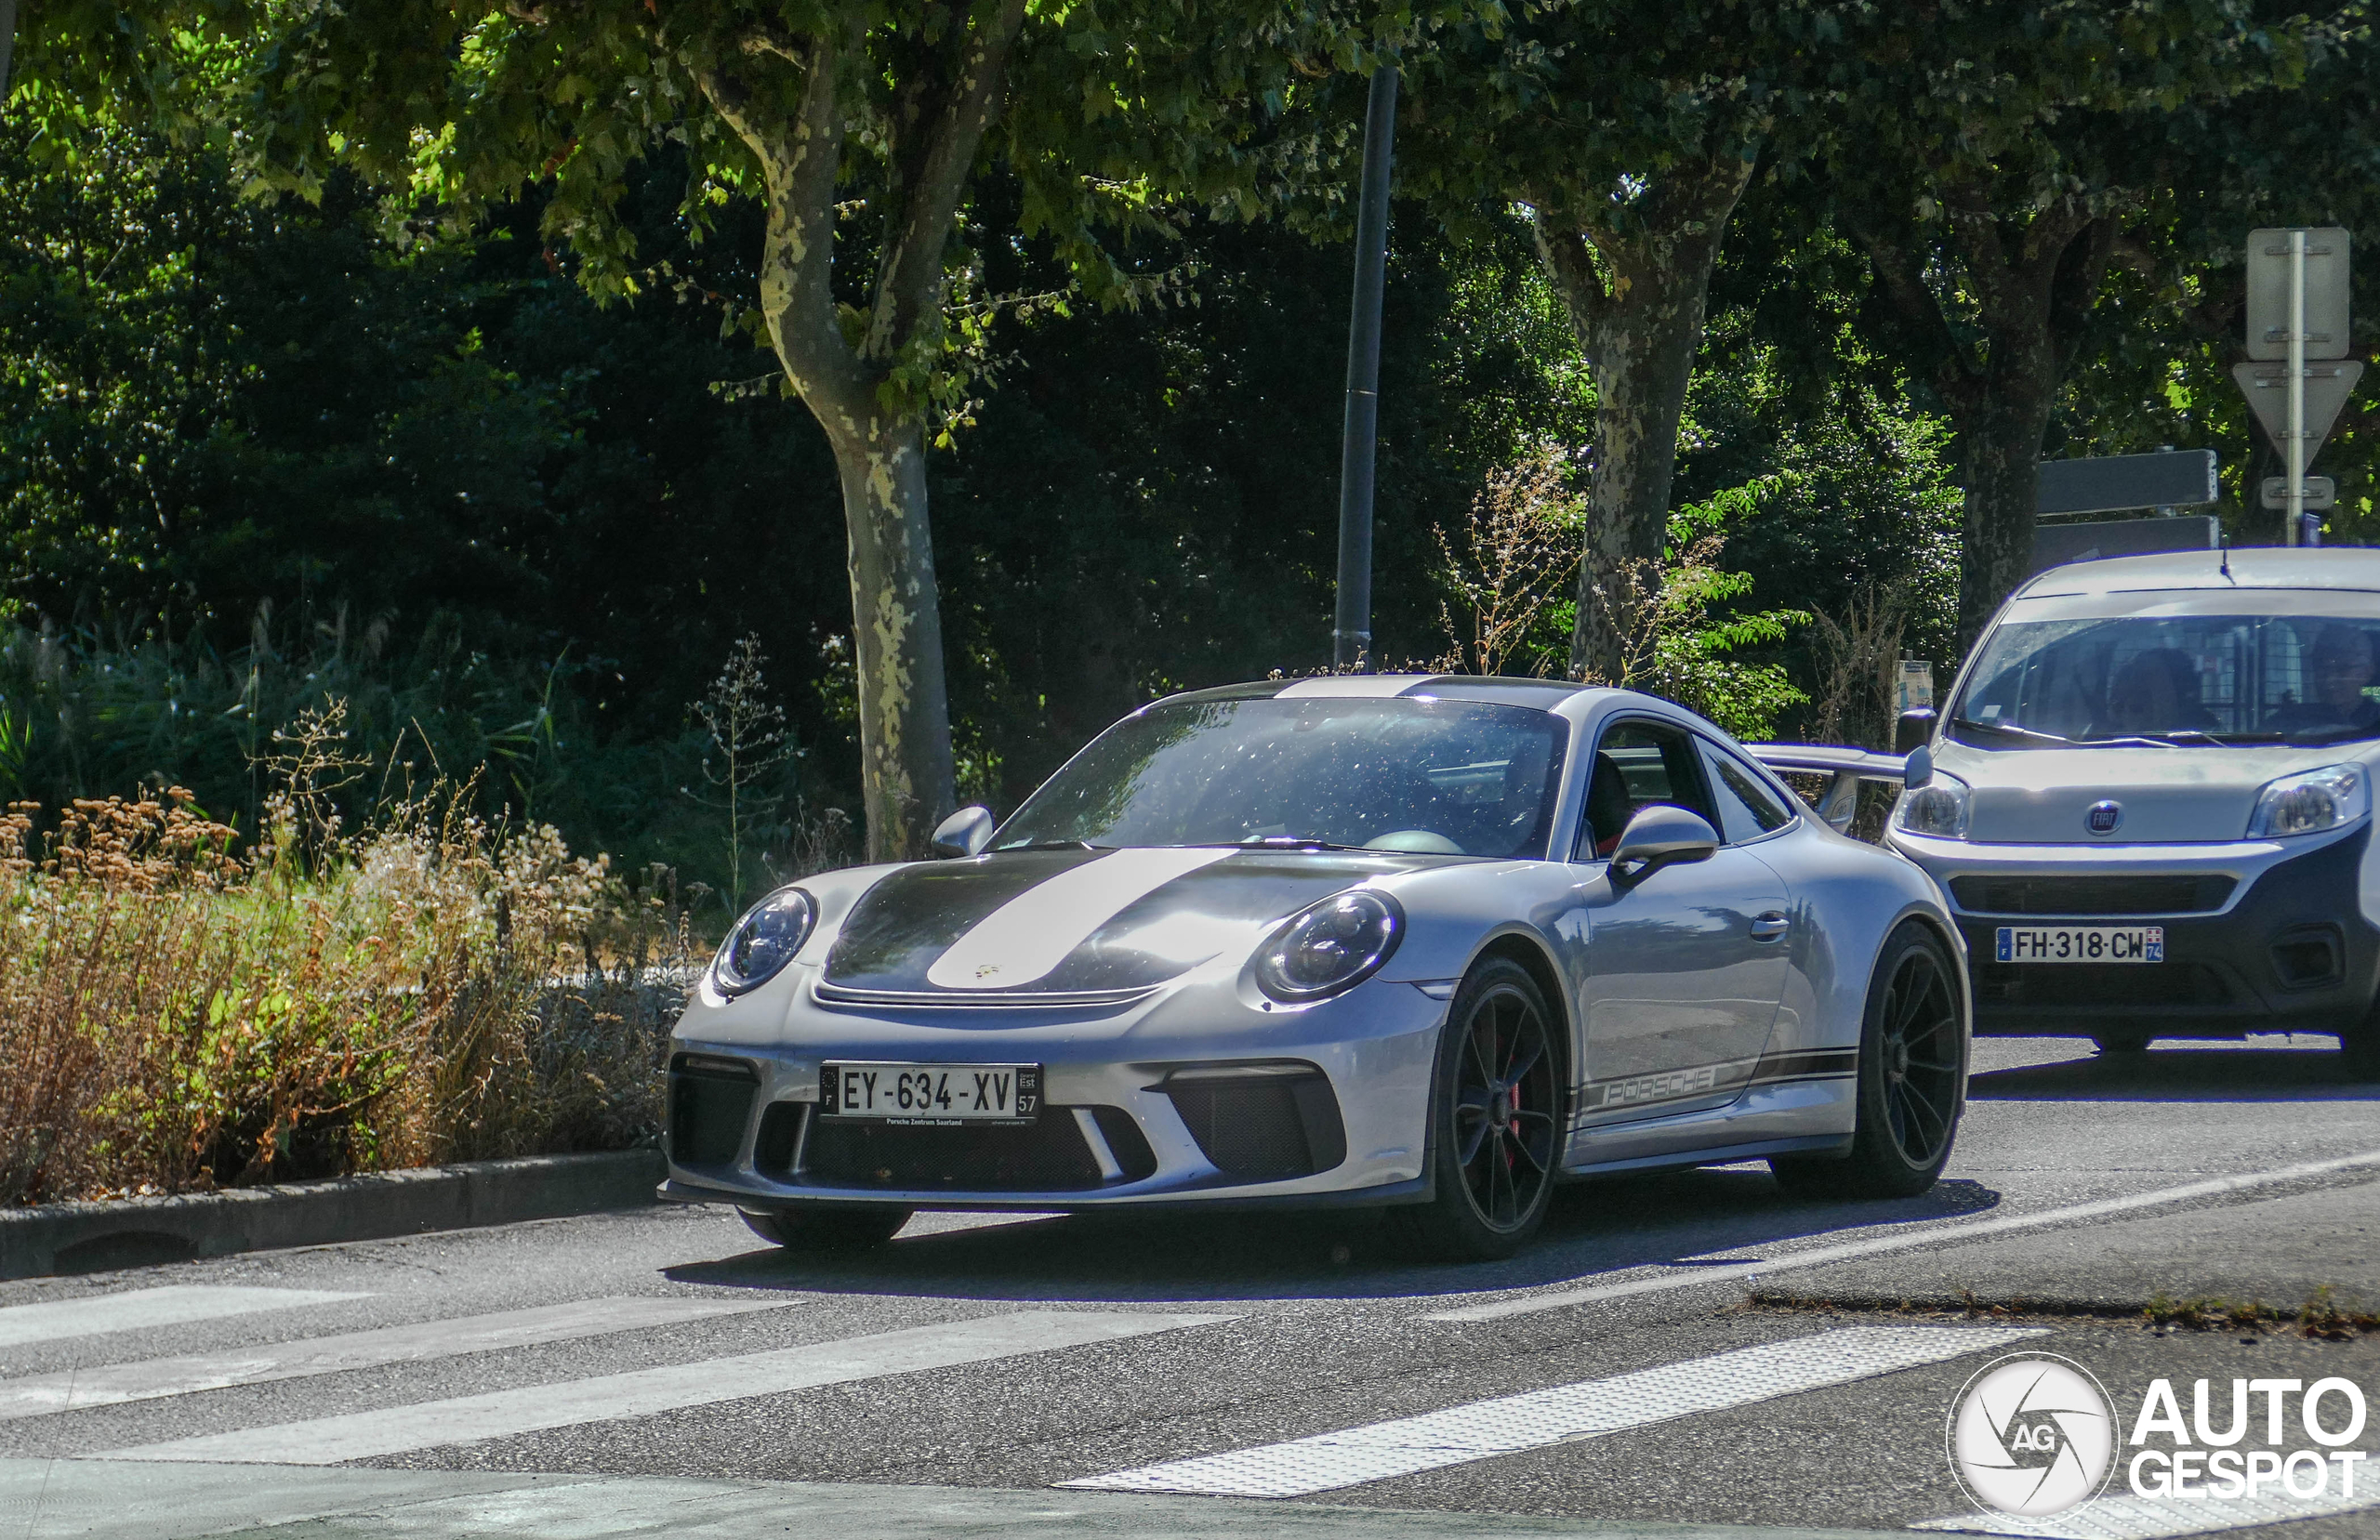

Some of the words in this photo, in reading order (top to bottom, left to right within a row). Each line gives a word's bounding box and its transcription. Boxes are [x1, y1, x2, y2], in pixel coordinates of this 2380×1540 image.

[2093, 812, 2115, 826] FIAT
[2016, 931, 2143, 958] FH-318-CW
[2002, 948, 2007, 956] F
[2148, 946, 2162, 958] 74
[1020, 1078, 1036, 1087] Est
[1606, 1070, 1712, 1104] PORSCHE
[844, 1072, 1010, 1111] EY-634-XV
[826, 1095, 833, 1106] F
[1018, 1096, 1037, 1112] 57
